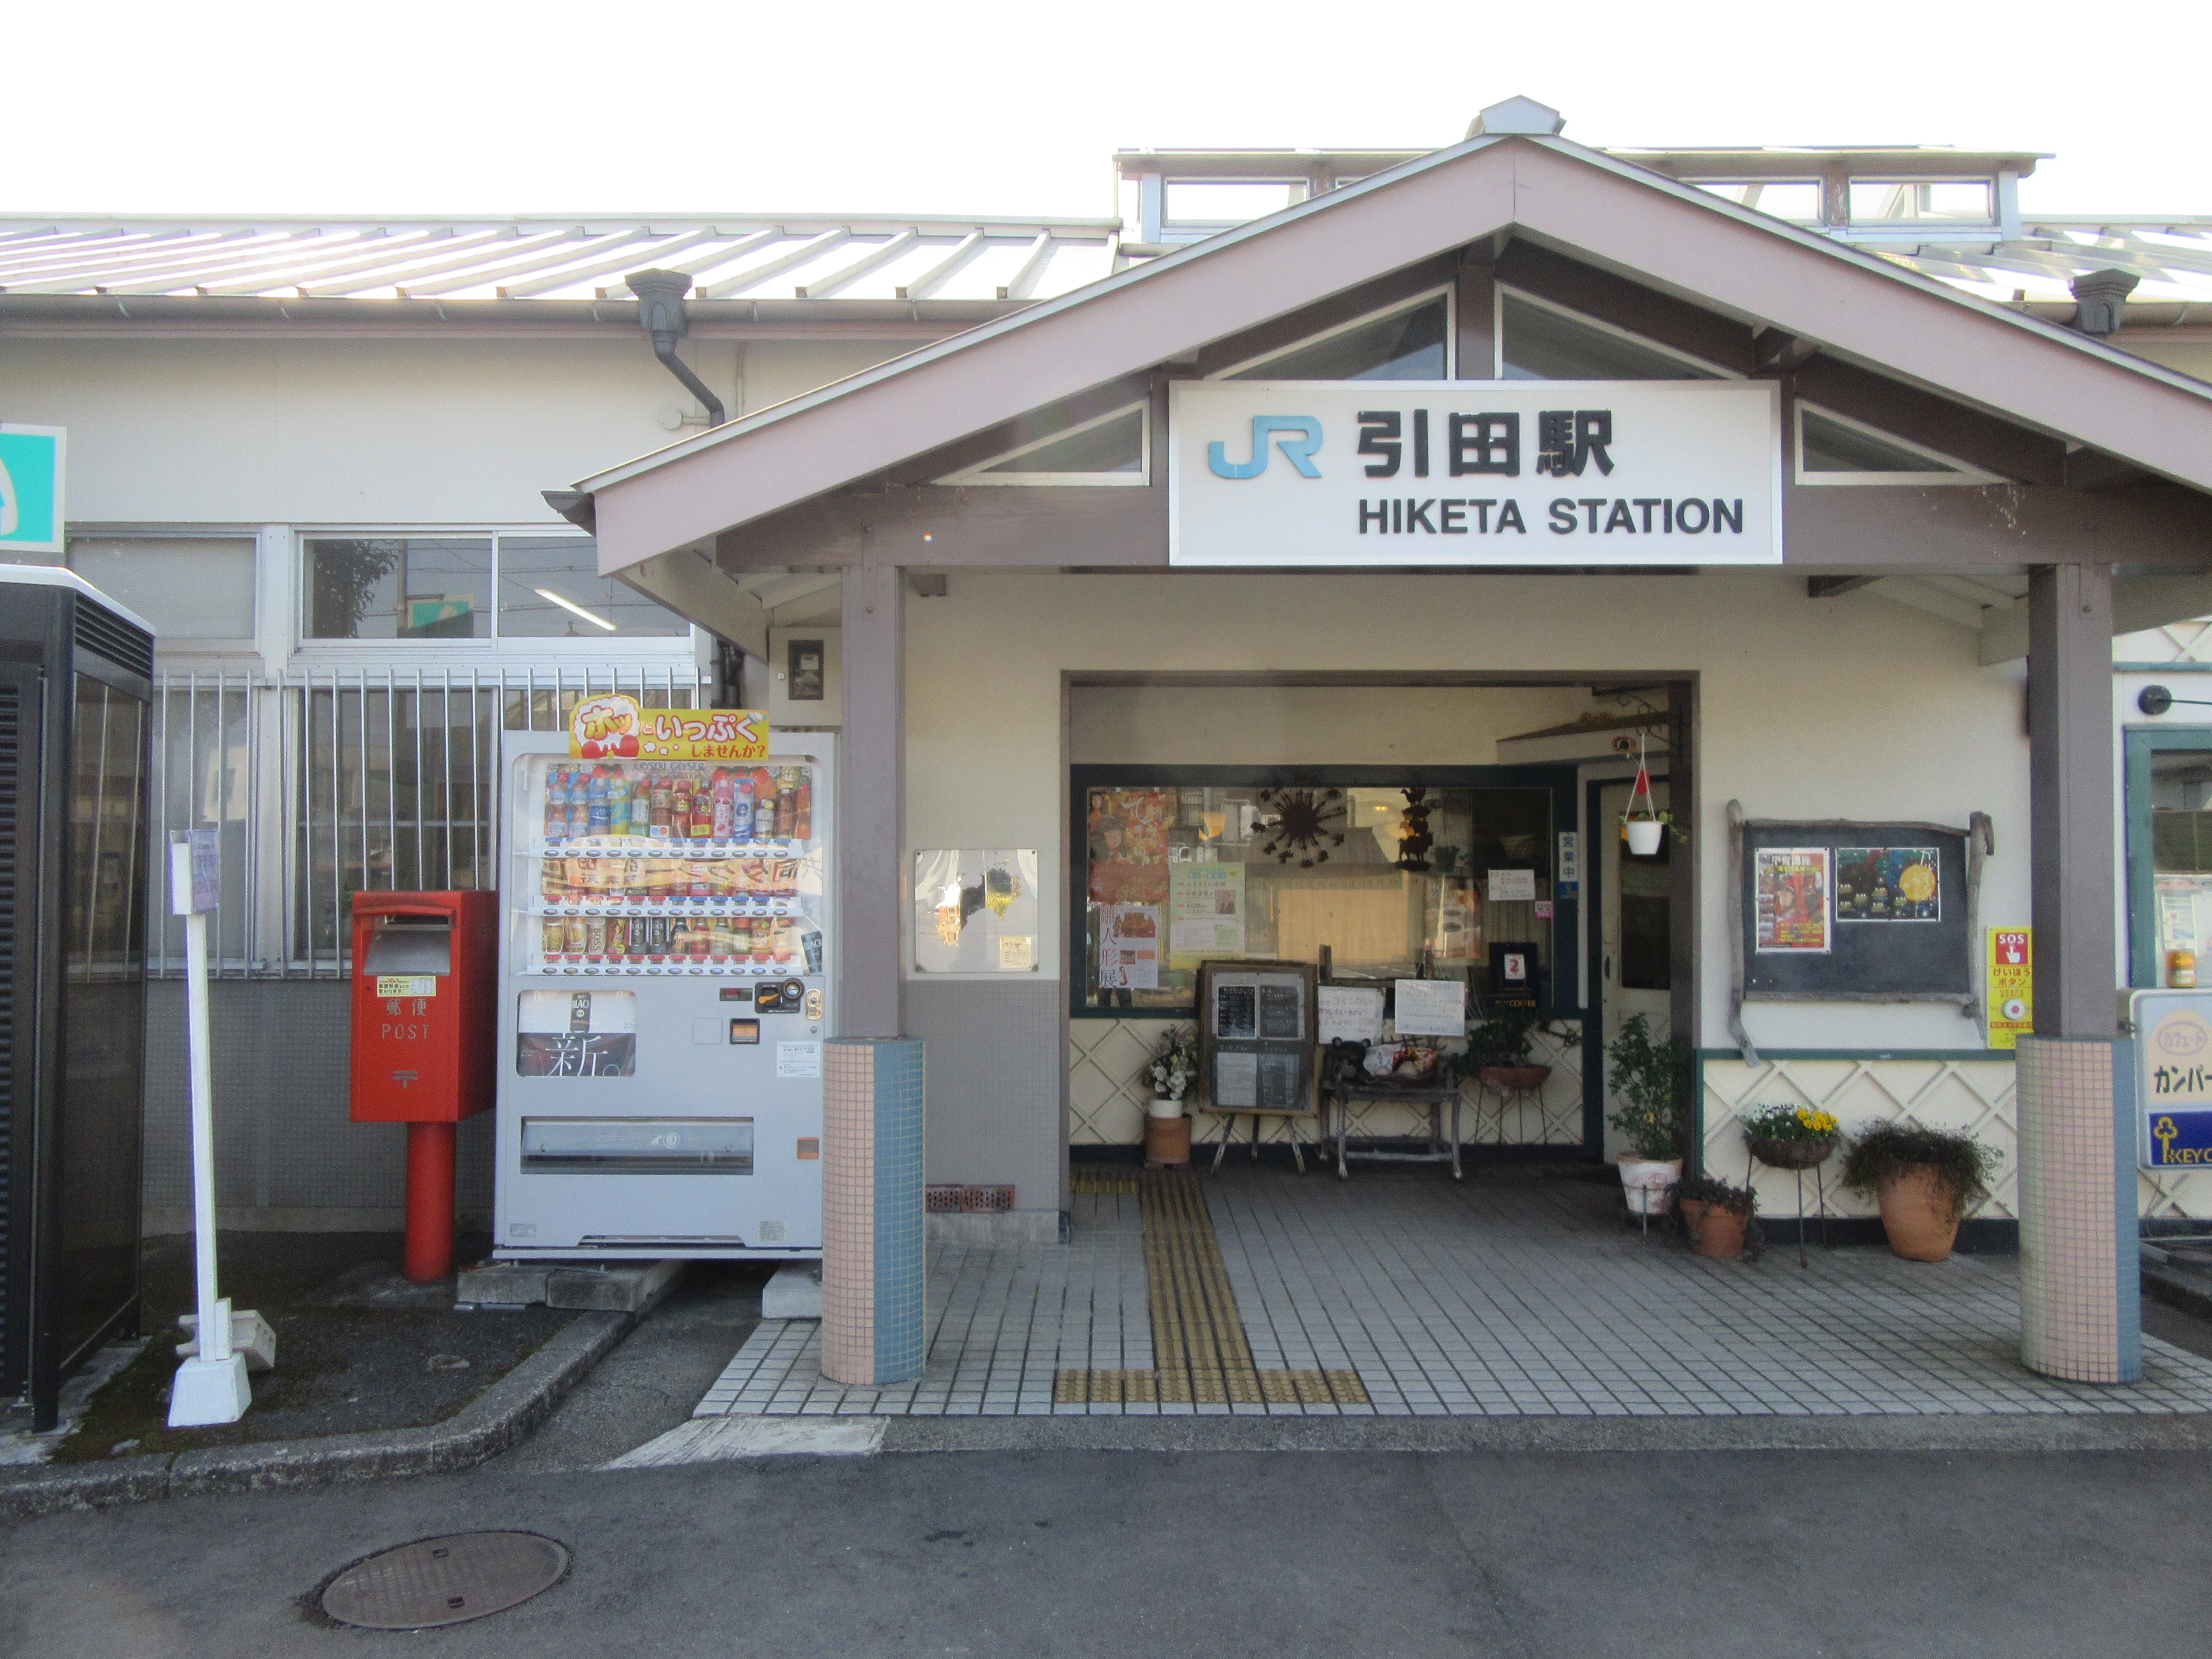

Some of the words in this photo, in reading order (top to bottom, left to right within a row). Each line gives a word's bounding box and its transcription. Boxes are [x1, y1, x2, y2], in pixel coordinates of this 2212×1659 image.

[1208, 415, 1323, 479] JR
[1357, 408, 1615, 478] 引田駅
[1358, 498, 1526, 534] HIKETA
[1548, 497, 1743, 536] STATION
[1563, 835, 1575, 878] 営業中
[1999, 934, 2025, 944] SOS
[1999, 978, 2026, 986] ボタン
[386, 998, 427, 1016] 郵便
[381, 1024, 430, 1039] POST
